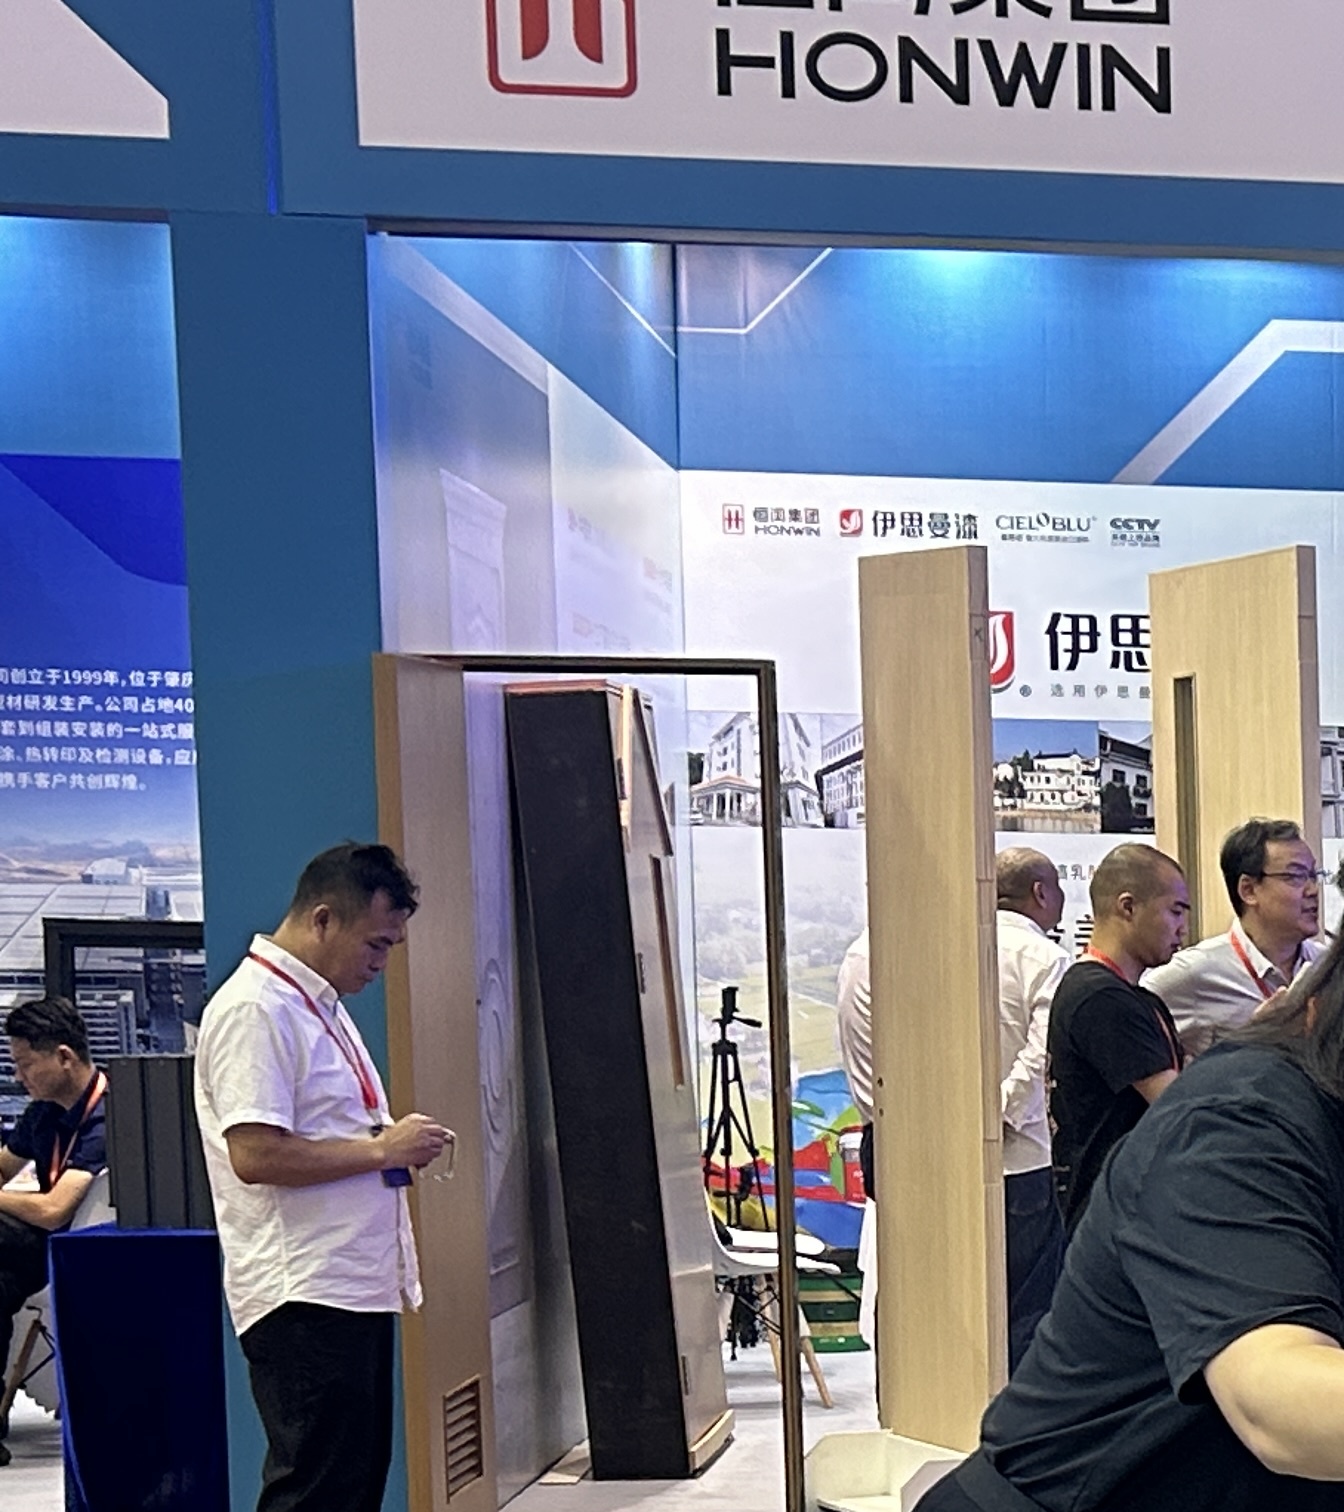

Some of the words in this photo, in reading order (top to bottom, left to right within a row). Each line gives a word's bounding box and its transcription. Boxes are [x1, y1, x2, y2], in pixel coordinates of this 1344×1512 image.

[715, 28, 1172, 114] HONWIN
[754, 524, 821, 537] HONWIN
[872, 510, 979, 540] 伊思曼漆
[1110, 518, 1160, 531] CCTV
[1045, 612, 1151, 672] 伊思
[0, 694, 195, 713] 材研发生产。公司占地40
